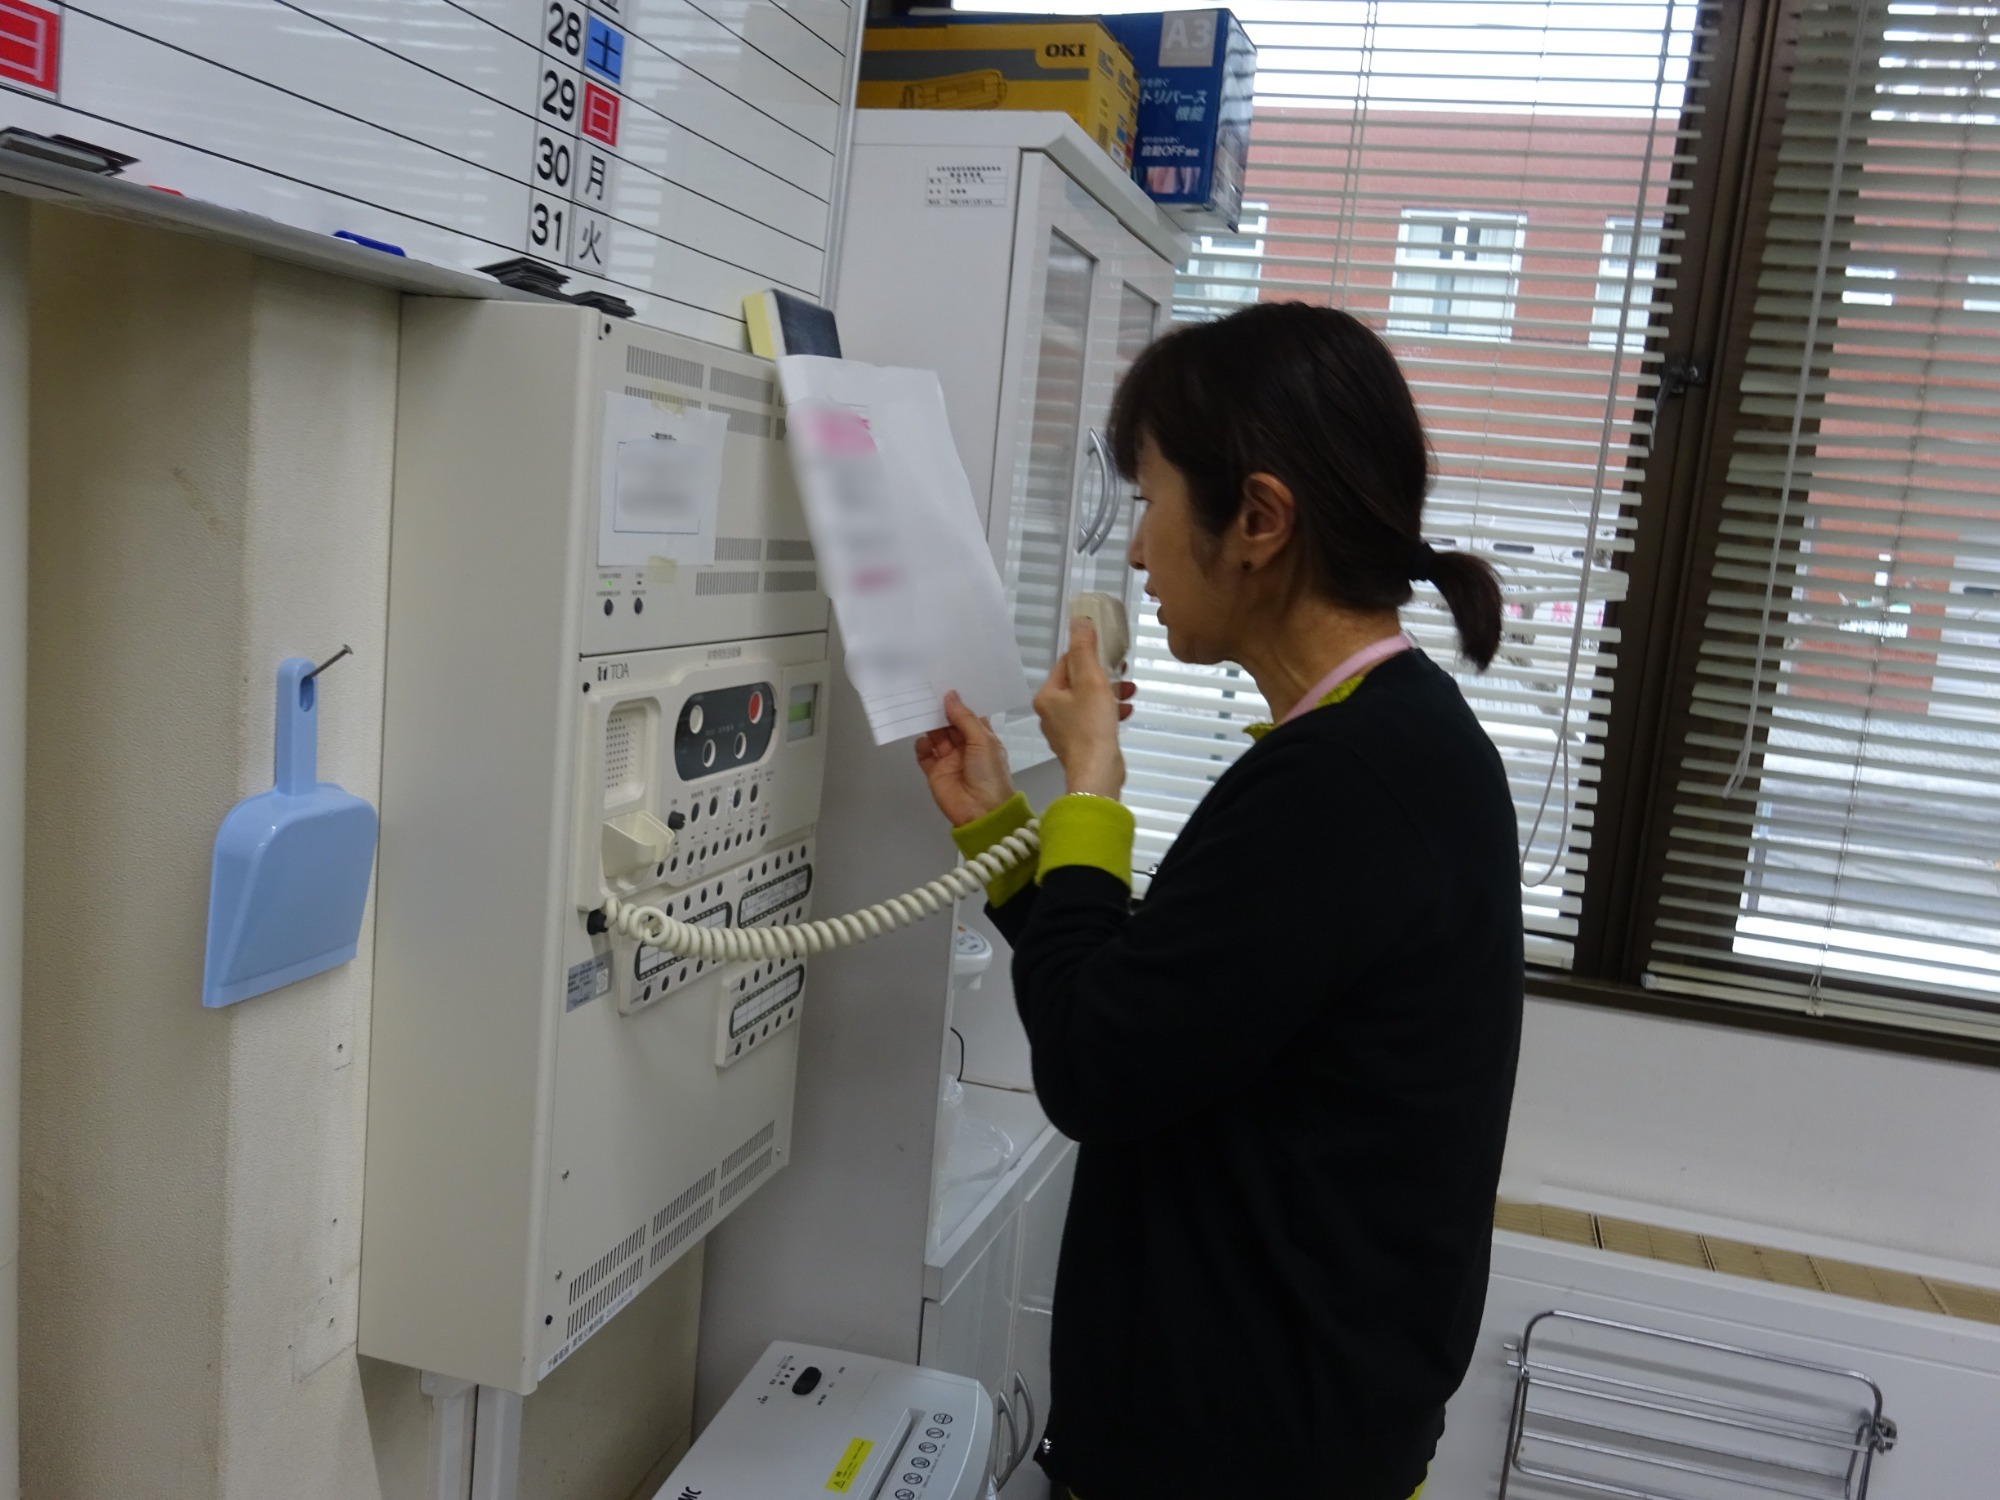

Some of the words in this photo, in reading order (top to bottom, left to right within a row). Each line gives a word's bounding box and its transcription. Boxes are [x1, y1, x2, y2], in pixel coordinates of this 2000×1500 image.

[548, 2, 581, 56] 28
[588, 30, 621, 80] 土
[1045, 43, 1086, 57] OKI
[1165, 17, 1213, 50] A3
[542, 70, 576, 122] 29
[588, 90, 615, 142] 日
[536, 137, 570, 187] 30
[585, 154, 606, 201] 月
[531, 203, 562, 252] 31
[579, 219, 602, 266] 火
[610, 662, 629, 680] TOA
